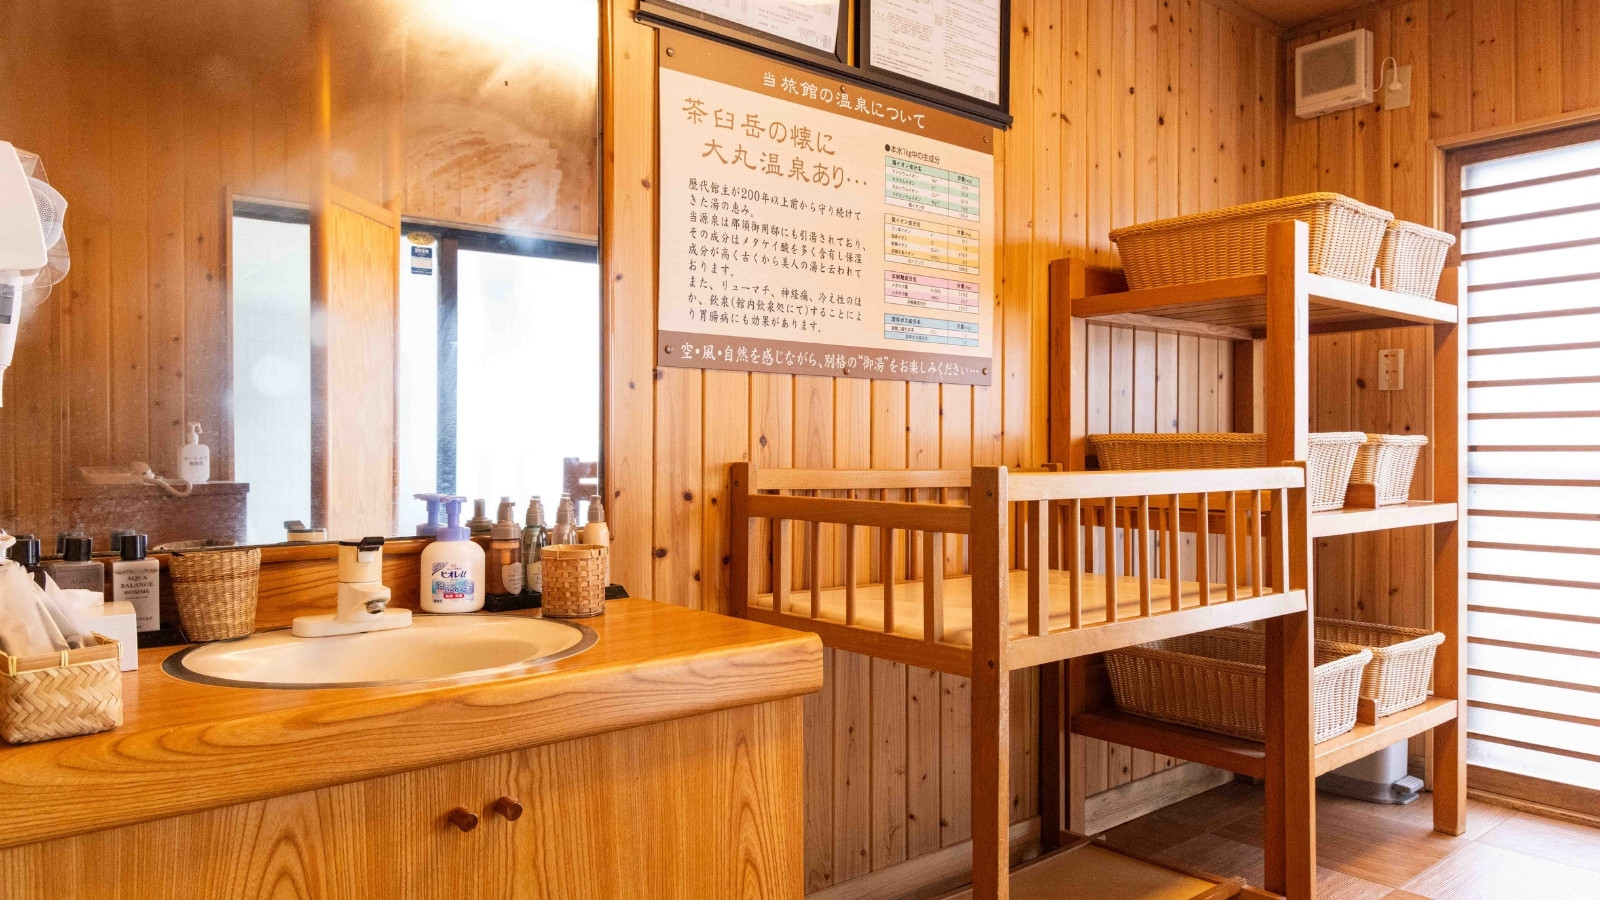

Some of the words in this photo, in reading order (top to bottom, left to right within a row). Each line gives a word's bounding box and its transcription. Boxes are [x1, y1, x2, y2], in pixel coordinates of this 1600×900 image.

[763, 72, 925, 128] 当旅館の温泉について
[683, 97, 836, 155] 茶臼岳の懐に
[688, 178, 861, 221] 歴代館主が200年以上前から守り続けて
[690, 194, 754, 218] きた湯の恵み。
[689, 211, 866, 252] 当源泉は那須御用邸にも引湯されており、
[690, 227, 862, 264] その成分はメタケイ酸を多く含有し保湿
[688, 243, 861, 278] 成分が高く古くから美人の湯と云われて
[689, 259, 734, 277] おります。
[689, 308, 821, 333] り胃腸病にも効果があります。
